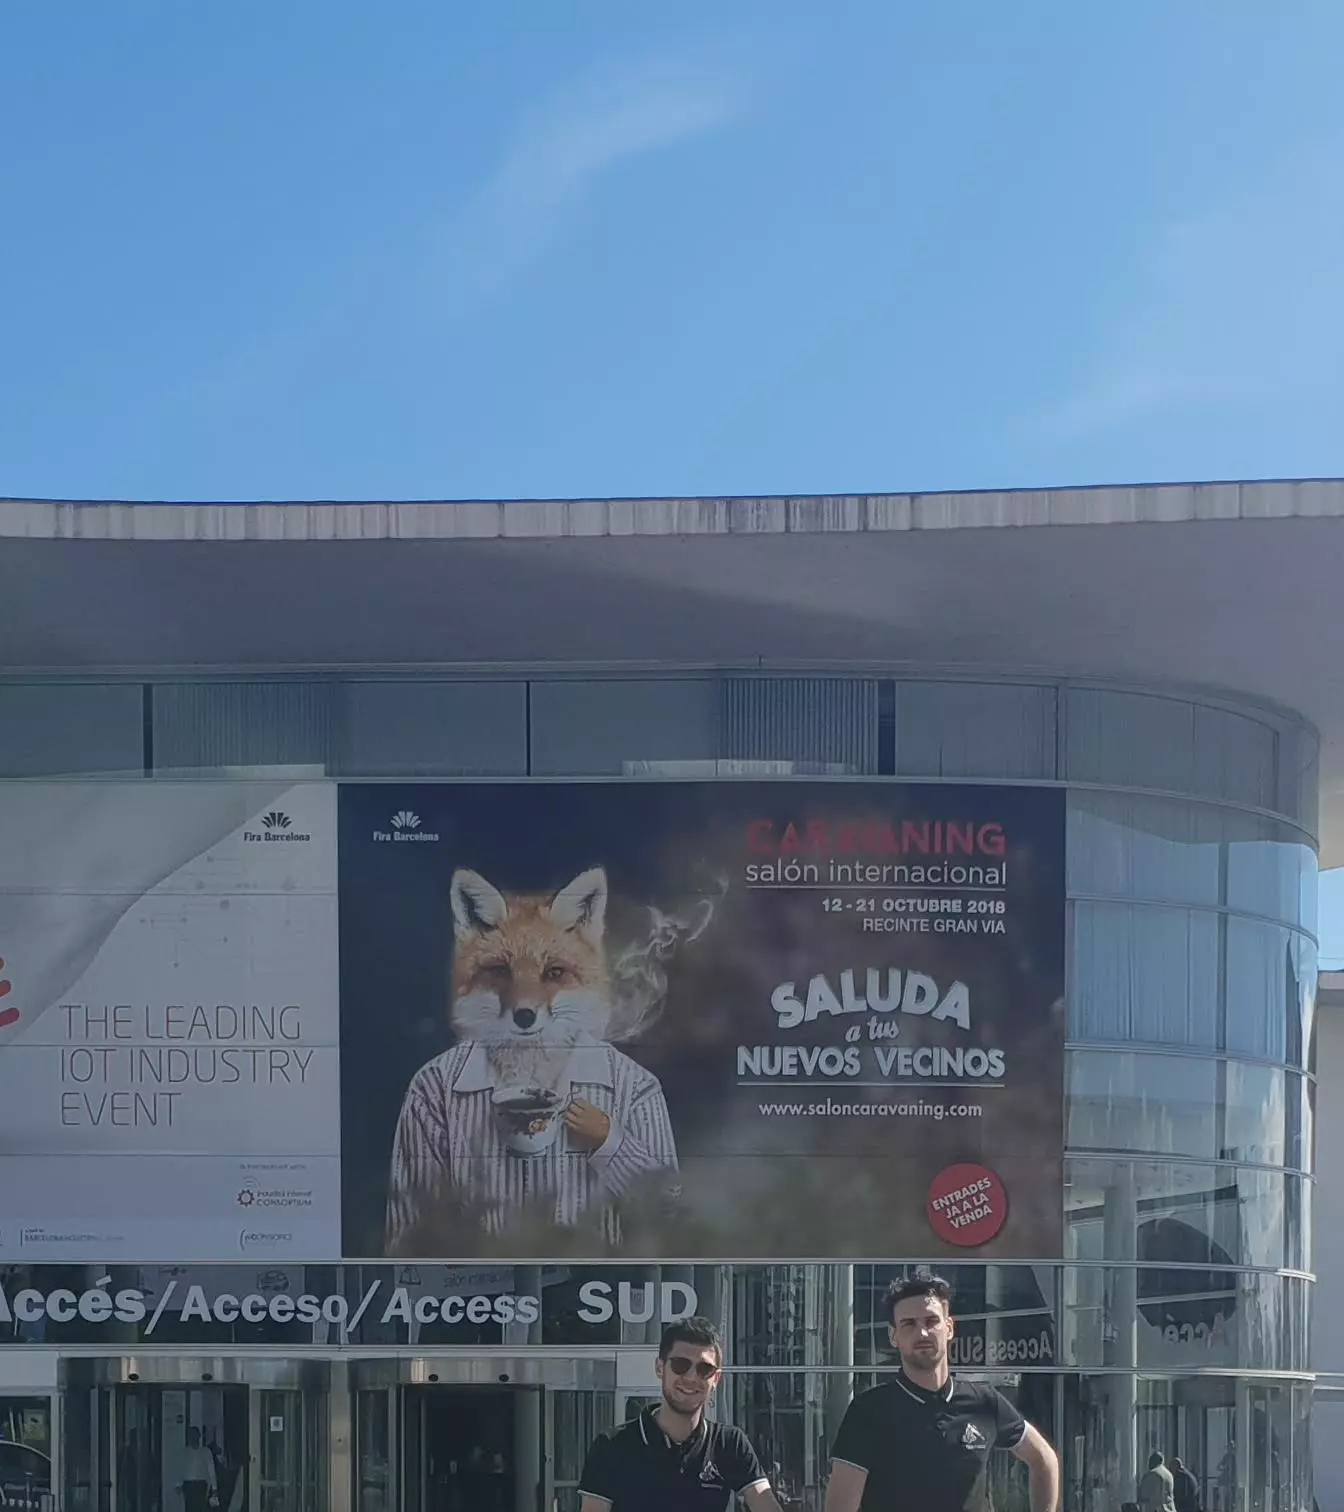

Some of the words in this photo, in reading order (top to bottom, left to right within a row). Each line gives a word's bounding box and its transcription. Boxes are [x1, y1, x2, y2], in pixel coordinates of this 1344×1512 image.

[244, 832, 262, 842] Fira
[264, 832, 311, 842] Barcelona
[373, 831, 391, 841] Fira
[394, 831, 439, 842] Barcelona
[747, 820, 1006, 855] CARAVANING
[745, 858, 818, 883] salón
[829, 859, 1006, 885] internacional
[822, 898, 843, 912] 12
[856, 898, 876, 912] 21
[882, 899, 962, 914] OCTUBRE
[967, 900, 1006, 914] 2018
[863, 918, 930, 933] RECINTE
[933, 919, 979, 934] GRAN
[981, 919, 1006, 934] VIA
[770, 967, 971, 1031] SALUDA
[59, 1005, 132, 1040] THE
[145, 1005, 301, 1041] LEADING
[845, 1025, 861, 1043] a
[867, 1015, 900, 1041] tus
[60, 1048, 118, 1083] IOT
[129, 1048, 315, 1084] INDUSTRY
[737, 1044, 862, 1077] NUEVOS
[873, 1045, 1006, 1078] VECINOS
[61, 1091, 183, 1128] EVENT
[759, 1098, 983, 1121] www.saloncaravaning.com
[932, 1177, 993, 1212] ENTRADES
[946, 1205, 961, 1219] JA
[962, 1200, 973, 1212] A
[972, 1193, 990, 1206] LA
[950, 1204, 993, 1229] VENDA
[577, 1280, 698, 1323] SUD
